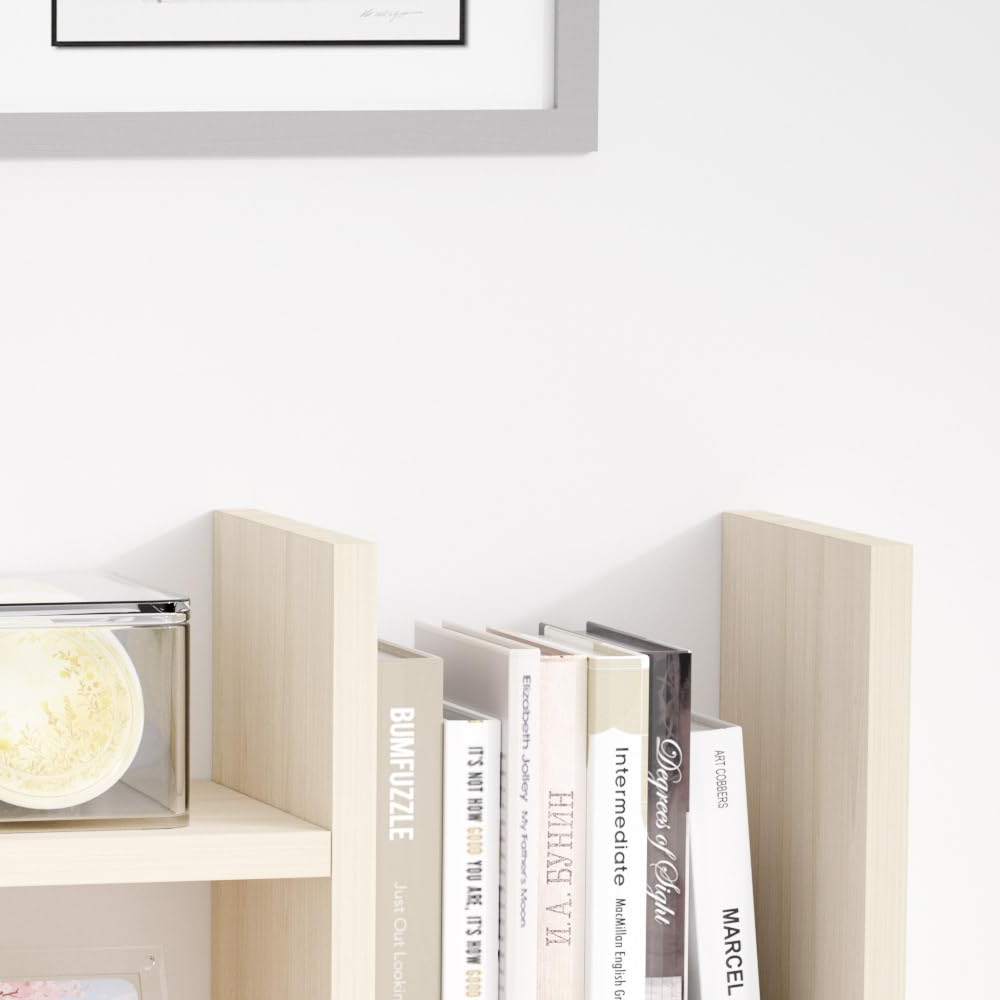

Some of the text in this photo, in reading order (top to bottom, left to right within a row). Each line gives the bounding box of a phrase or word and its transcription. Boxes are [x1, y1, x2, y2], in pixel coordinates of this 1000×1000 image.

[519, 674, 532, 802] Elizabeth Jolley
[467, 746, 483, 767] IT'S
[389, 709, 415, 841] BUMFUZZLE
[467, 772, 483, 793] NOT
[713, 750, 729, 809] ART COBBERS
[467, 798, 483, 822] HOW
[614, 747, 629, 887] Intermediate
[466, 827, 483, 856] GOOD
[646, 736, 683, 925] Degrees of Sight
[466, 860, 482, 881] YOU
[393, 881, 408, 912] Just
[465, 886, 482, 911] ARE,
[393, 917, 408, 947] Out
[465, 916, 482, 936] IT'S
[614, 898, 626, 948] MacMillan
[466, 940, 482, 965] HOW
[722, 908, 744, 996] MARCEL
[465, 969, 482, 998] GOOD
[611, 951, 626, 986] English
